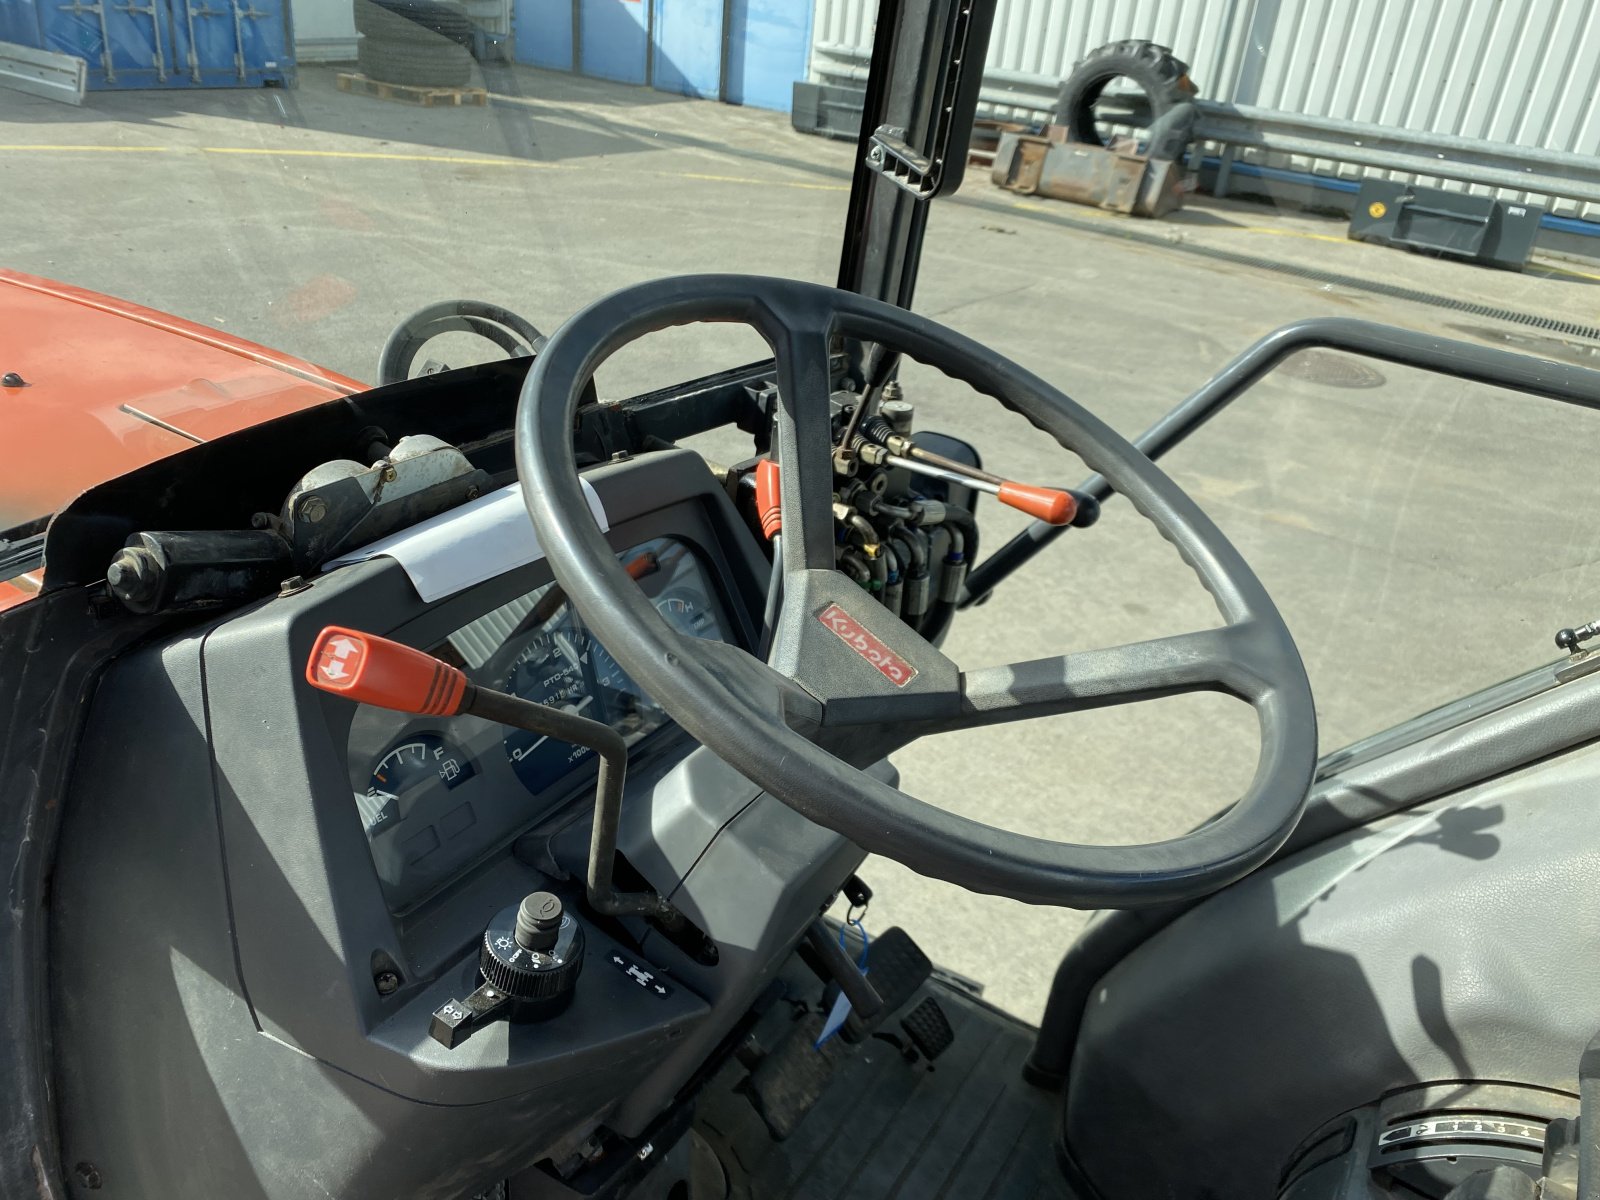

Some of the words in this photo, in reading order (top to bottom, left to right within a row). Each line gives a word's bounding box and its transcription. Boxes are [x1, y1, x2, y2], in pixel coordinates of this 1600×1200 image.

[825, 610, 904, 681] Kubota
[553, 648, 562, 658] 2
[602, 676, 611, 687] 3
[433, 746, 444, 760] F
[512, 747, 523, 759] 0
[367, 811, 388, 826] UEL
[1475, 1123, 1483, 1131] 2
[1497, 1125, 1506, 1133] 3
[1520, 1129, 1530, 1137] 4
